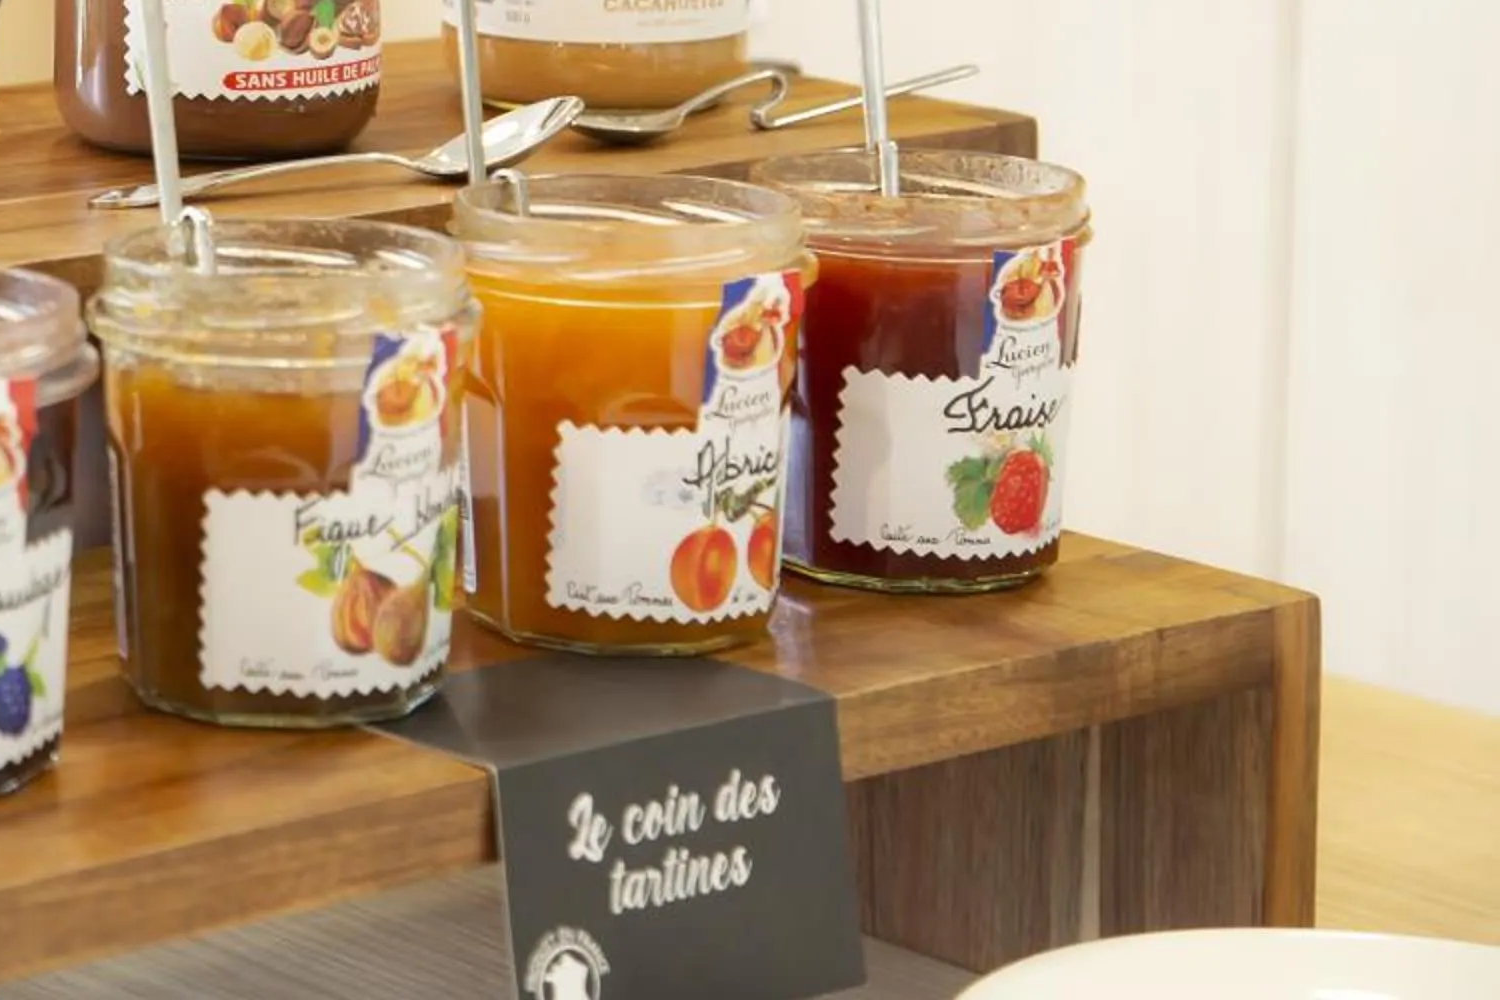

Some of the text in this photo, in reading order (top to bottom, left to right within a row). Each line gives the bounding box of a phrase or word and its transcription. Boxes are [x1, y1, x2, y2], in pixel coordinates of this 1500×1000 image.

[234, 71, 288, 90] SANS
[292, 66, 340, 87] HUILE
[342, 64, 359, 81] DE
[985, 336, 1050, 369] Lucien
[705, 385, 771, 420] Lucien
[944, 376, 1066, 433] Fraise
[682, 436, 777, 504] Abric
[293, 498, 394, 564] Figue
[567, 768, 781, 862] Le coin des
[609, 845, 752, 915] tartines
